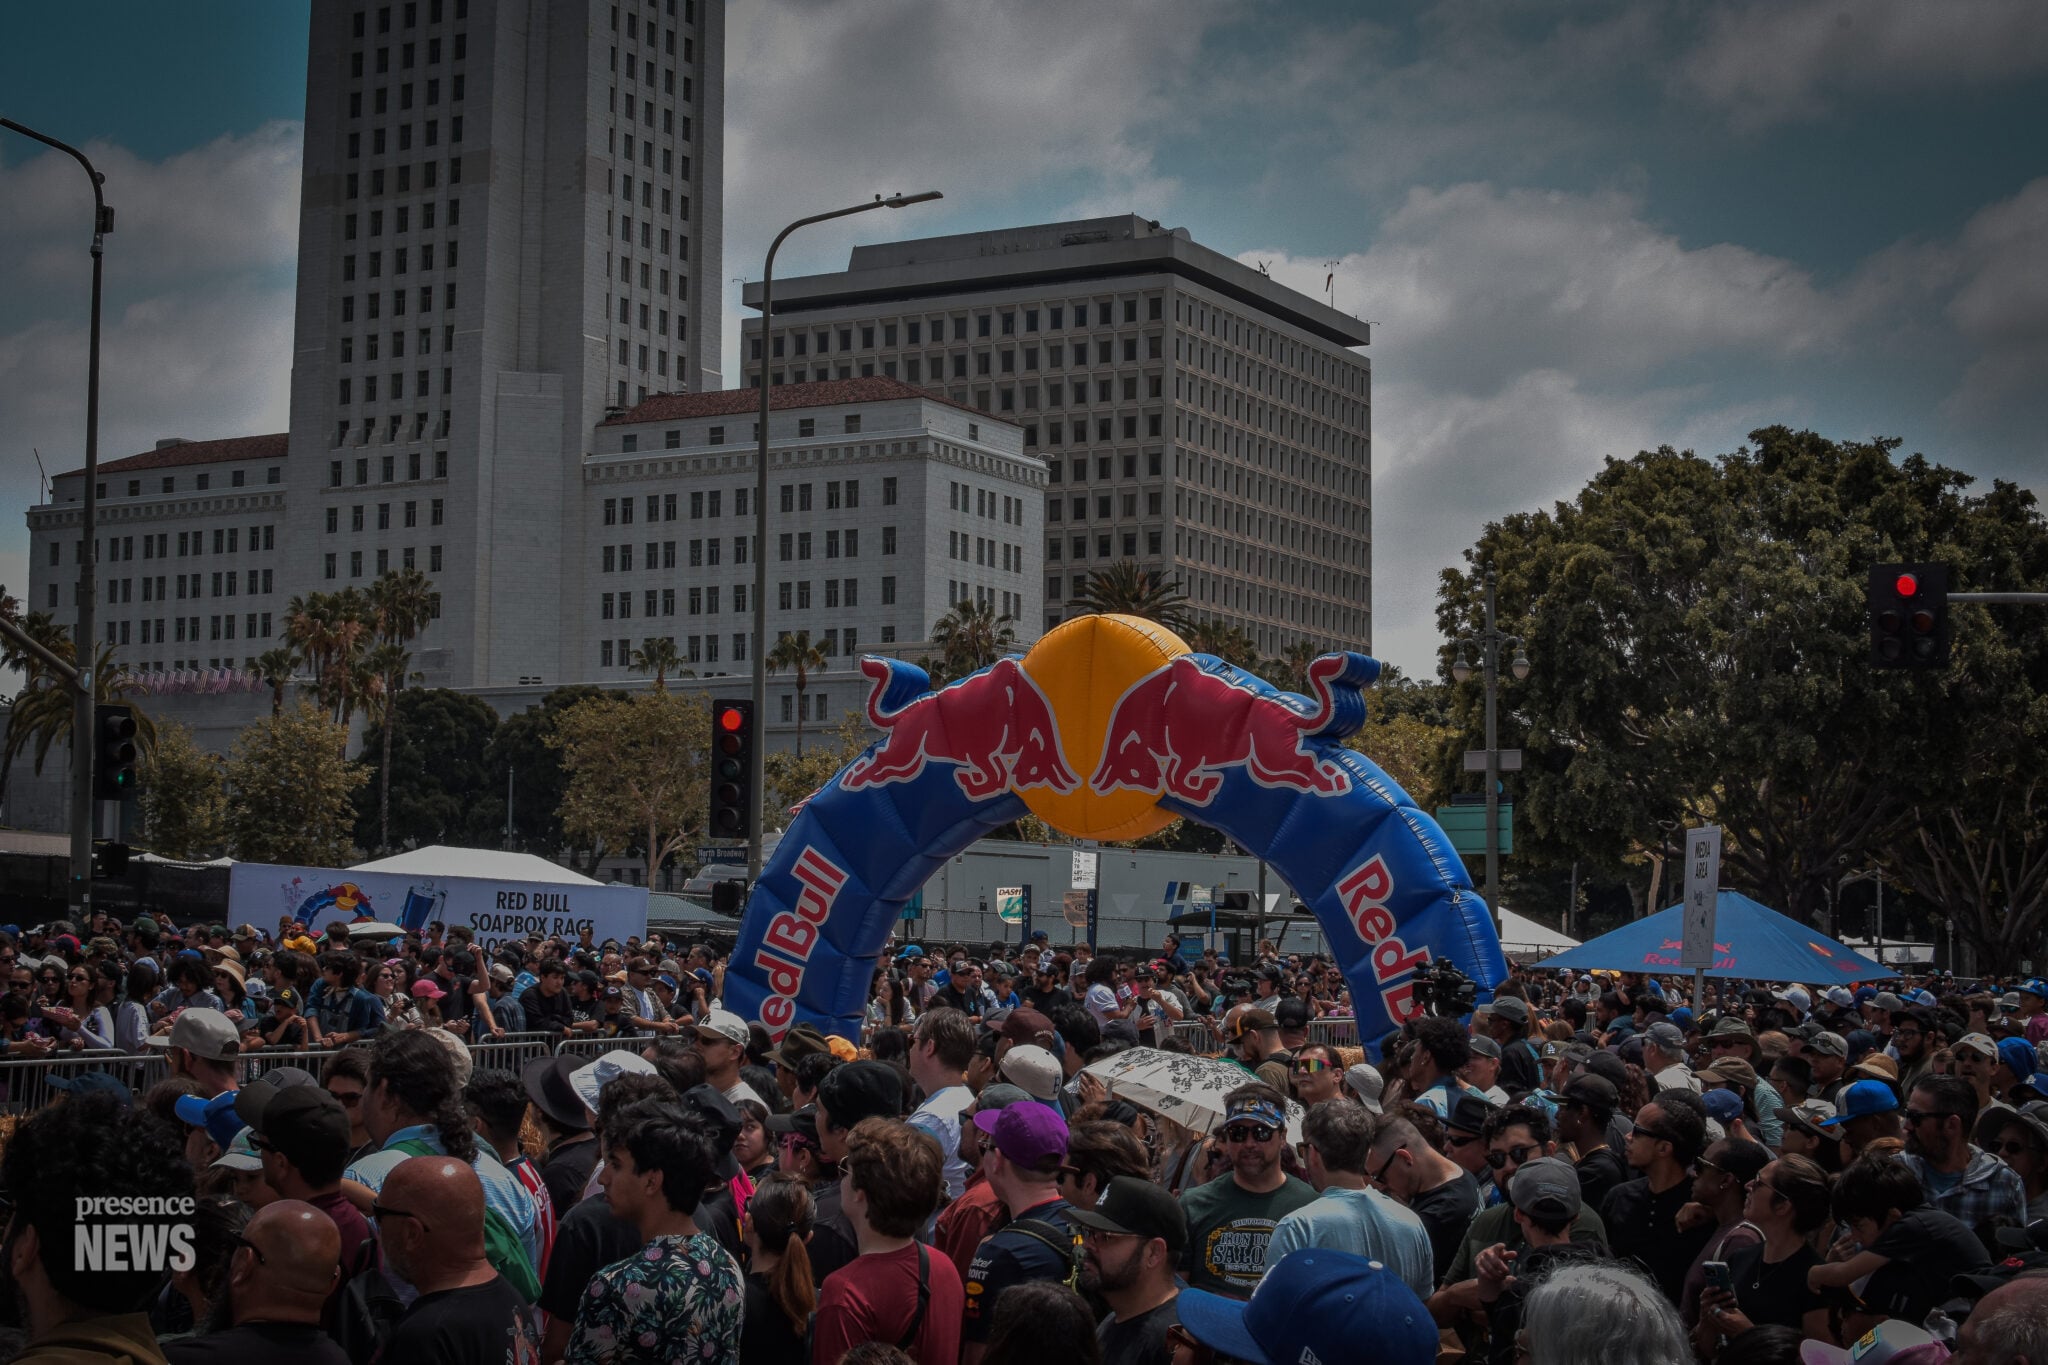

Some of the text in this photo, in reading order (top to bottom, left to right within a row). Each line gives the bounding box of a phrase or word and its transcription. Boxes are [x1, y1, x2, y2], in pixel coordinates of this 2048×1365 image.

[698, 848, 746, 859] North Broadway
[1695, 841, 1711, 858] MEDIA
[1695, 861, 1708, 879] AREA
[998, 888, 1022, 896] DASH
[496, 891, 571, 913] RED BULL
[764, 847, 847, 960] Bull
[469, 912, 548, 935] SOAPBOX
[1337, 855, 1430, 982] Red
[1220, 1231, 1271, 1246] IRON DO
[1212, 1244, 1266, 1265] SALO
